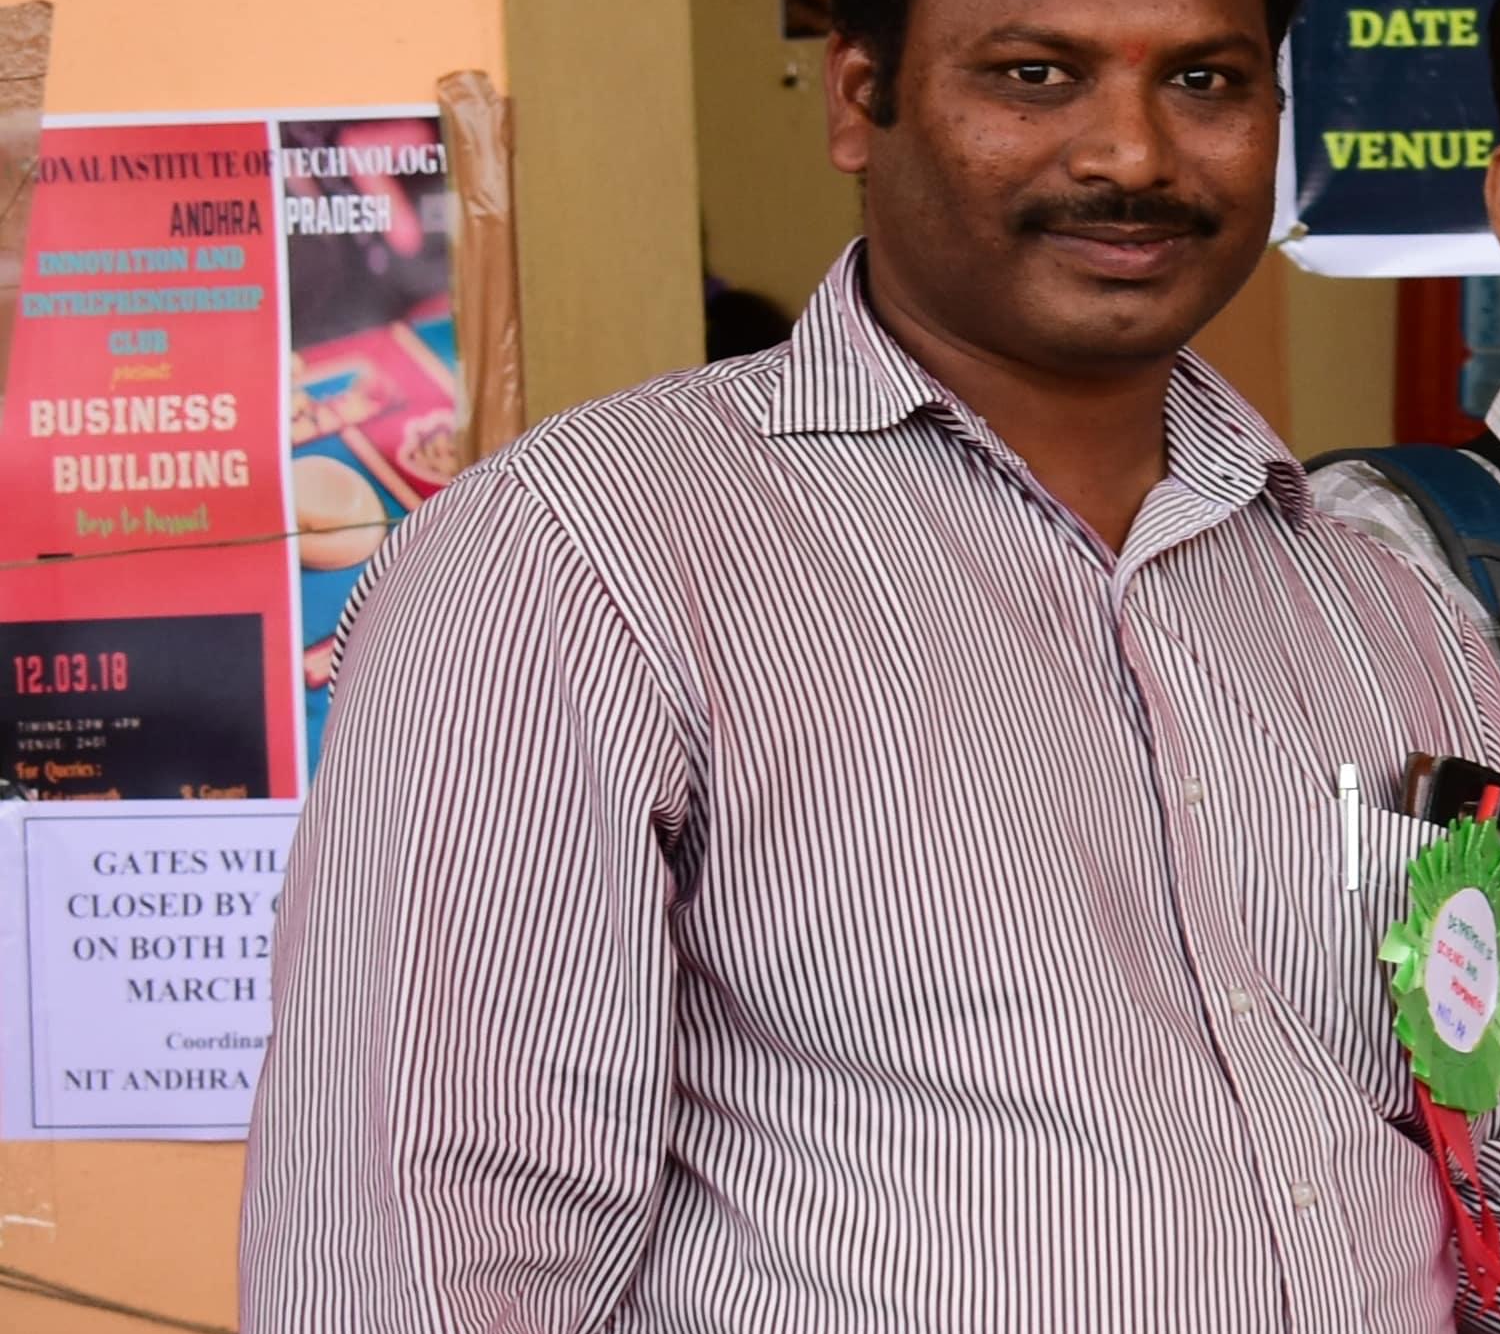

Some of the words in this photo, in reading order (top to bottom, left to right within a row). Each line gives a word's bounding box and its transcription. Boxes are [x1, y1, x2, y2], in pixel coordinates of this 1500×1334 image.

[1348, 8, 1479, 49] DATE
[1323, 130, 1494, 170] VENUE
[33, 156, 104, 186] ONAL
[110, 150, 240, 183] INSTITUTE
[170, 199, 263, 238] ANDHRA
[286, 193, 393, 235] PRADESH
[38, 246, 188, 276] INNOVATION
[194, 244, 245, 273] AND
[21, 286, 264, 319] ENTREPRENEURSHIP
[108, 329, 169, 356] CLUB
[29, 393, 237, 437] BUSINESS
[53, 449, 250, 494] BUILDING
[14, 651, 129, 694] 12.03.18
[93, 849, 207, 876] GATES
[67, 892, 202, 919] CLOSED
[215, 891, 260, 917] BY
[73, 934, 119, 961] ON
[129, 933, 224, 960] BOTH
[239, 934, 269, 959] 12
[126, 976, 255, 1003] MARCH
[64, 1069, 111, 1091] NIT
[121, 1068, 250, 1091] ANDHRA
